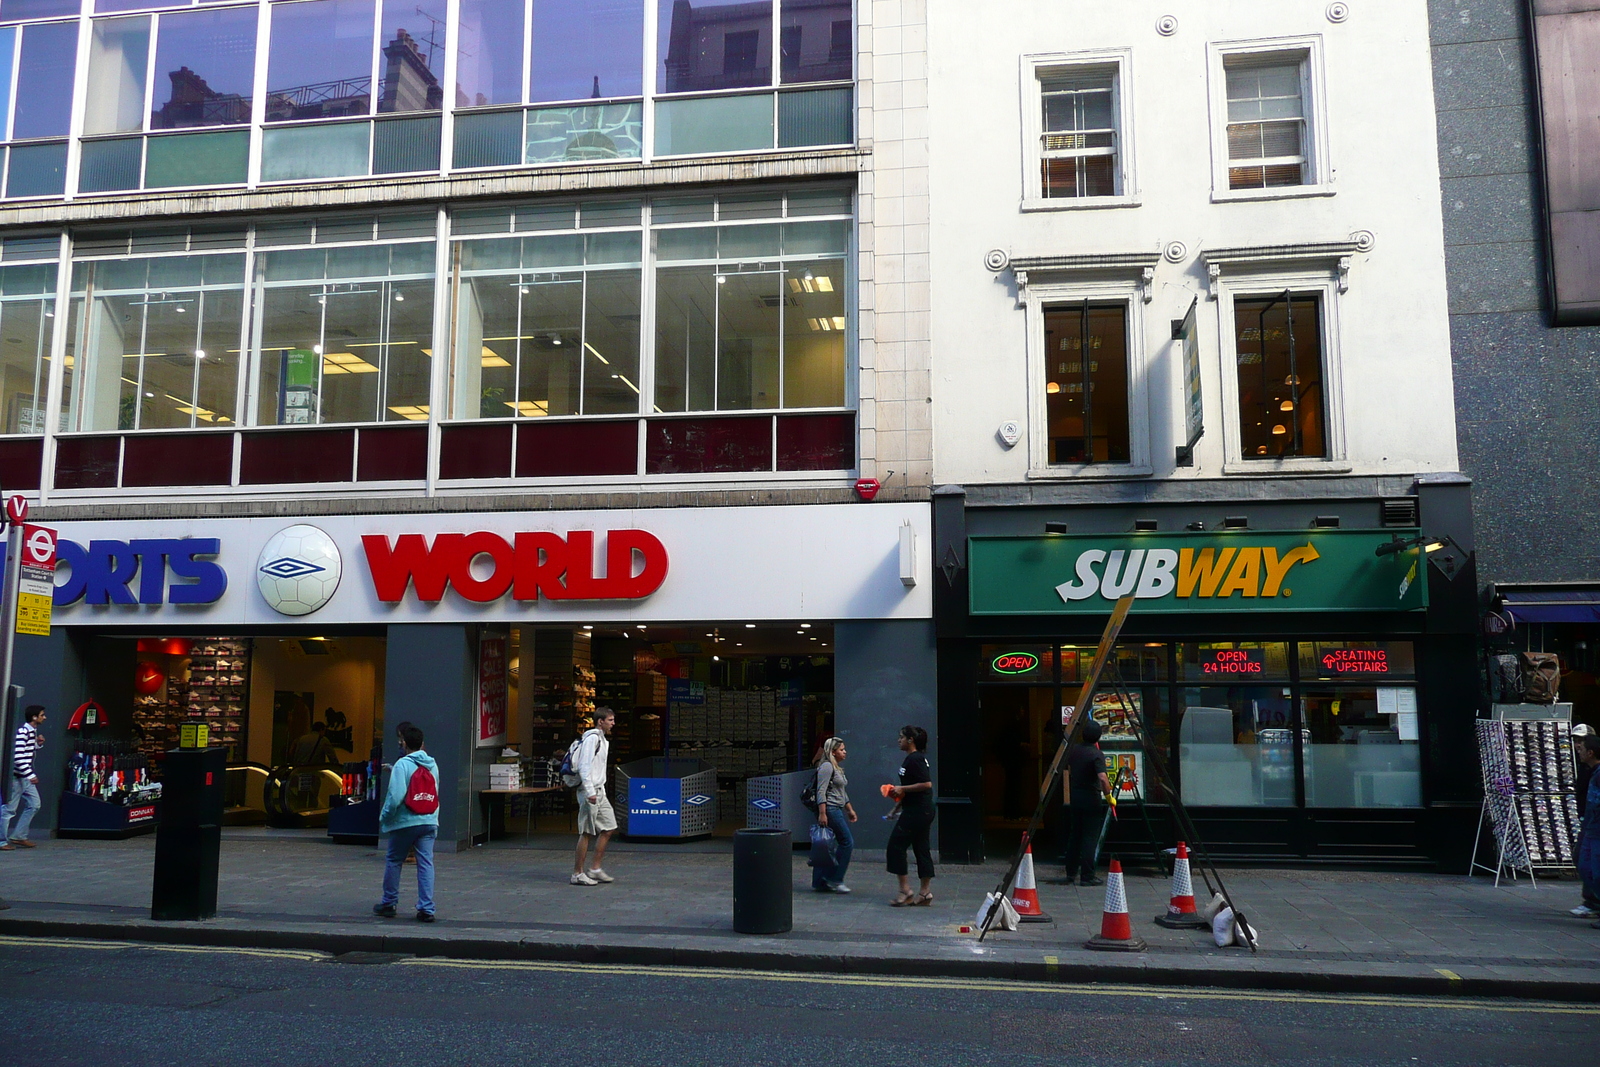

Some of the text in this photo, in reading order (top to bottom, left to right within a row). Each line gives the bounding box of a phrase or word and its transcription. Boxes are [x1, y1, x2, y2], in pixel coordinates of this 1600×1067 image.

[13, 496, 26, 517] V
[0, 528, 669, 606] ORTS WORLD
[1055, 541, 1320, 603] SUBWAY
[998, 656, 1033, 669] OPEN
[1216, 651, 1248, 662] OPEN
[1335, 650, 1386, 661] SEATING
[482, 659, 503, 678] SALE
[1203, 662, 1261, 673] 24 HOURS
[1336, 661, 1389, 672] UPSTAIRS
[481, 679, 505, 698] SHOES
[482, 697, 505, 717] MUST
[487, 716, 501, 736] GO!
[130, 808, 154, 817] DONNAY
